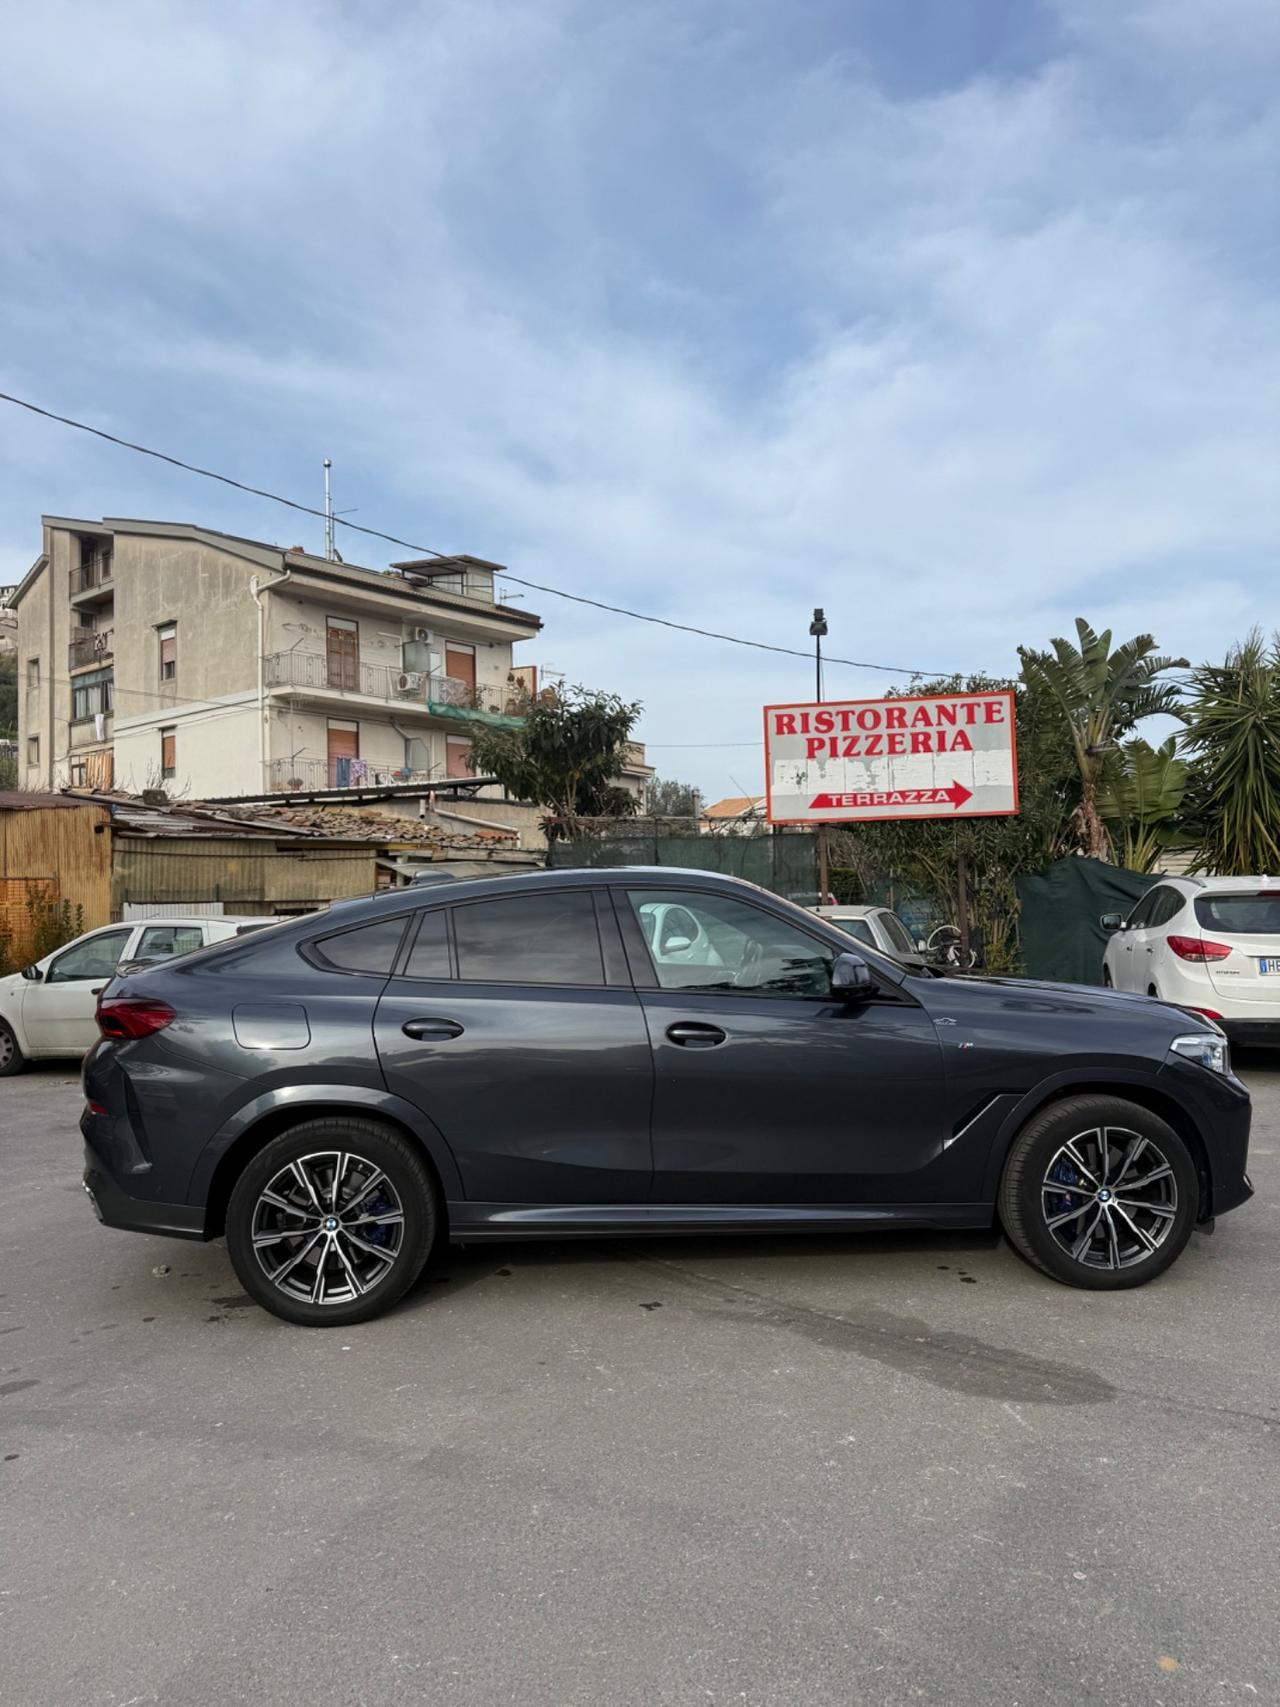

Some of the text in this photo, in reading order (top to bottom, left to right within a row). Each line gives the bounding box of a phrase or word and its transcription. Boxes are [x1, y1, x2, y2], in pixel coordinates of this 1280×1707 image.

[775, 701, 1004, 735] RISTORANTE
[806, 730, 973, 759] PIZZERIA
[828, 791, 951, 807] TERRAZZA
